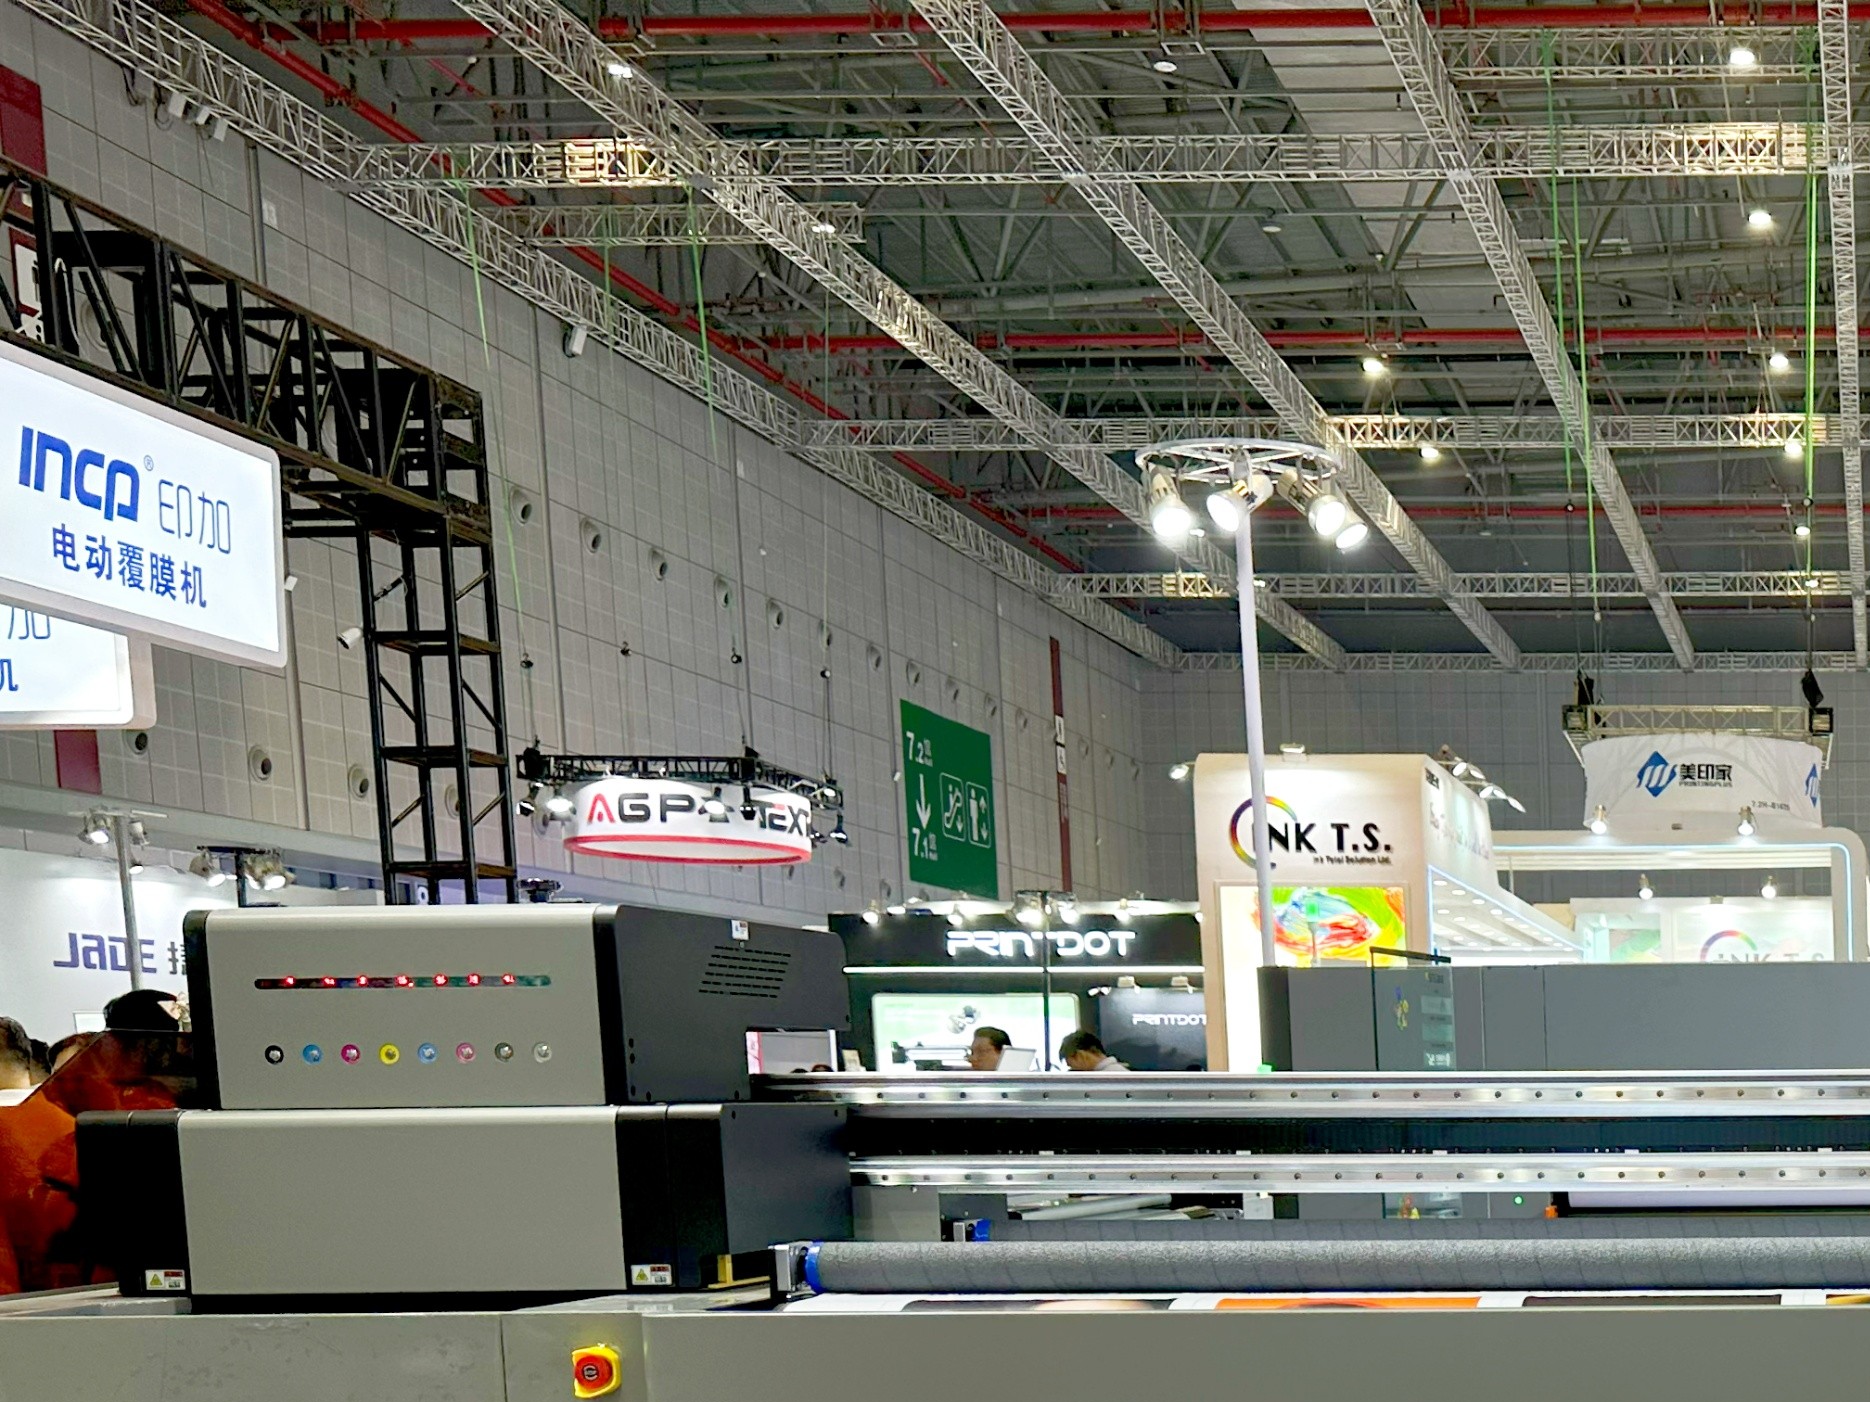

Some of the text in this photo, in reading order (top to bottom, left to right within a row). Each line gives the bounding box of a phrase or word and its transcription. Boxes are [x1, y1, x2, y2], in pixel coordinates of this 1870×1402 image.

[158, 479, 231, 554] 印加
[52, 523, 207, 608] 电动覆膜机
[1680, 763, 1733, 781] 美印家
[1252, 823, 1317, 853] NK
